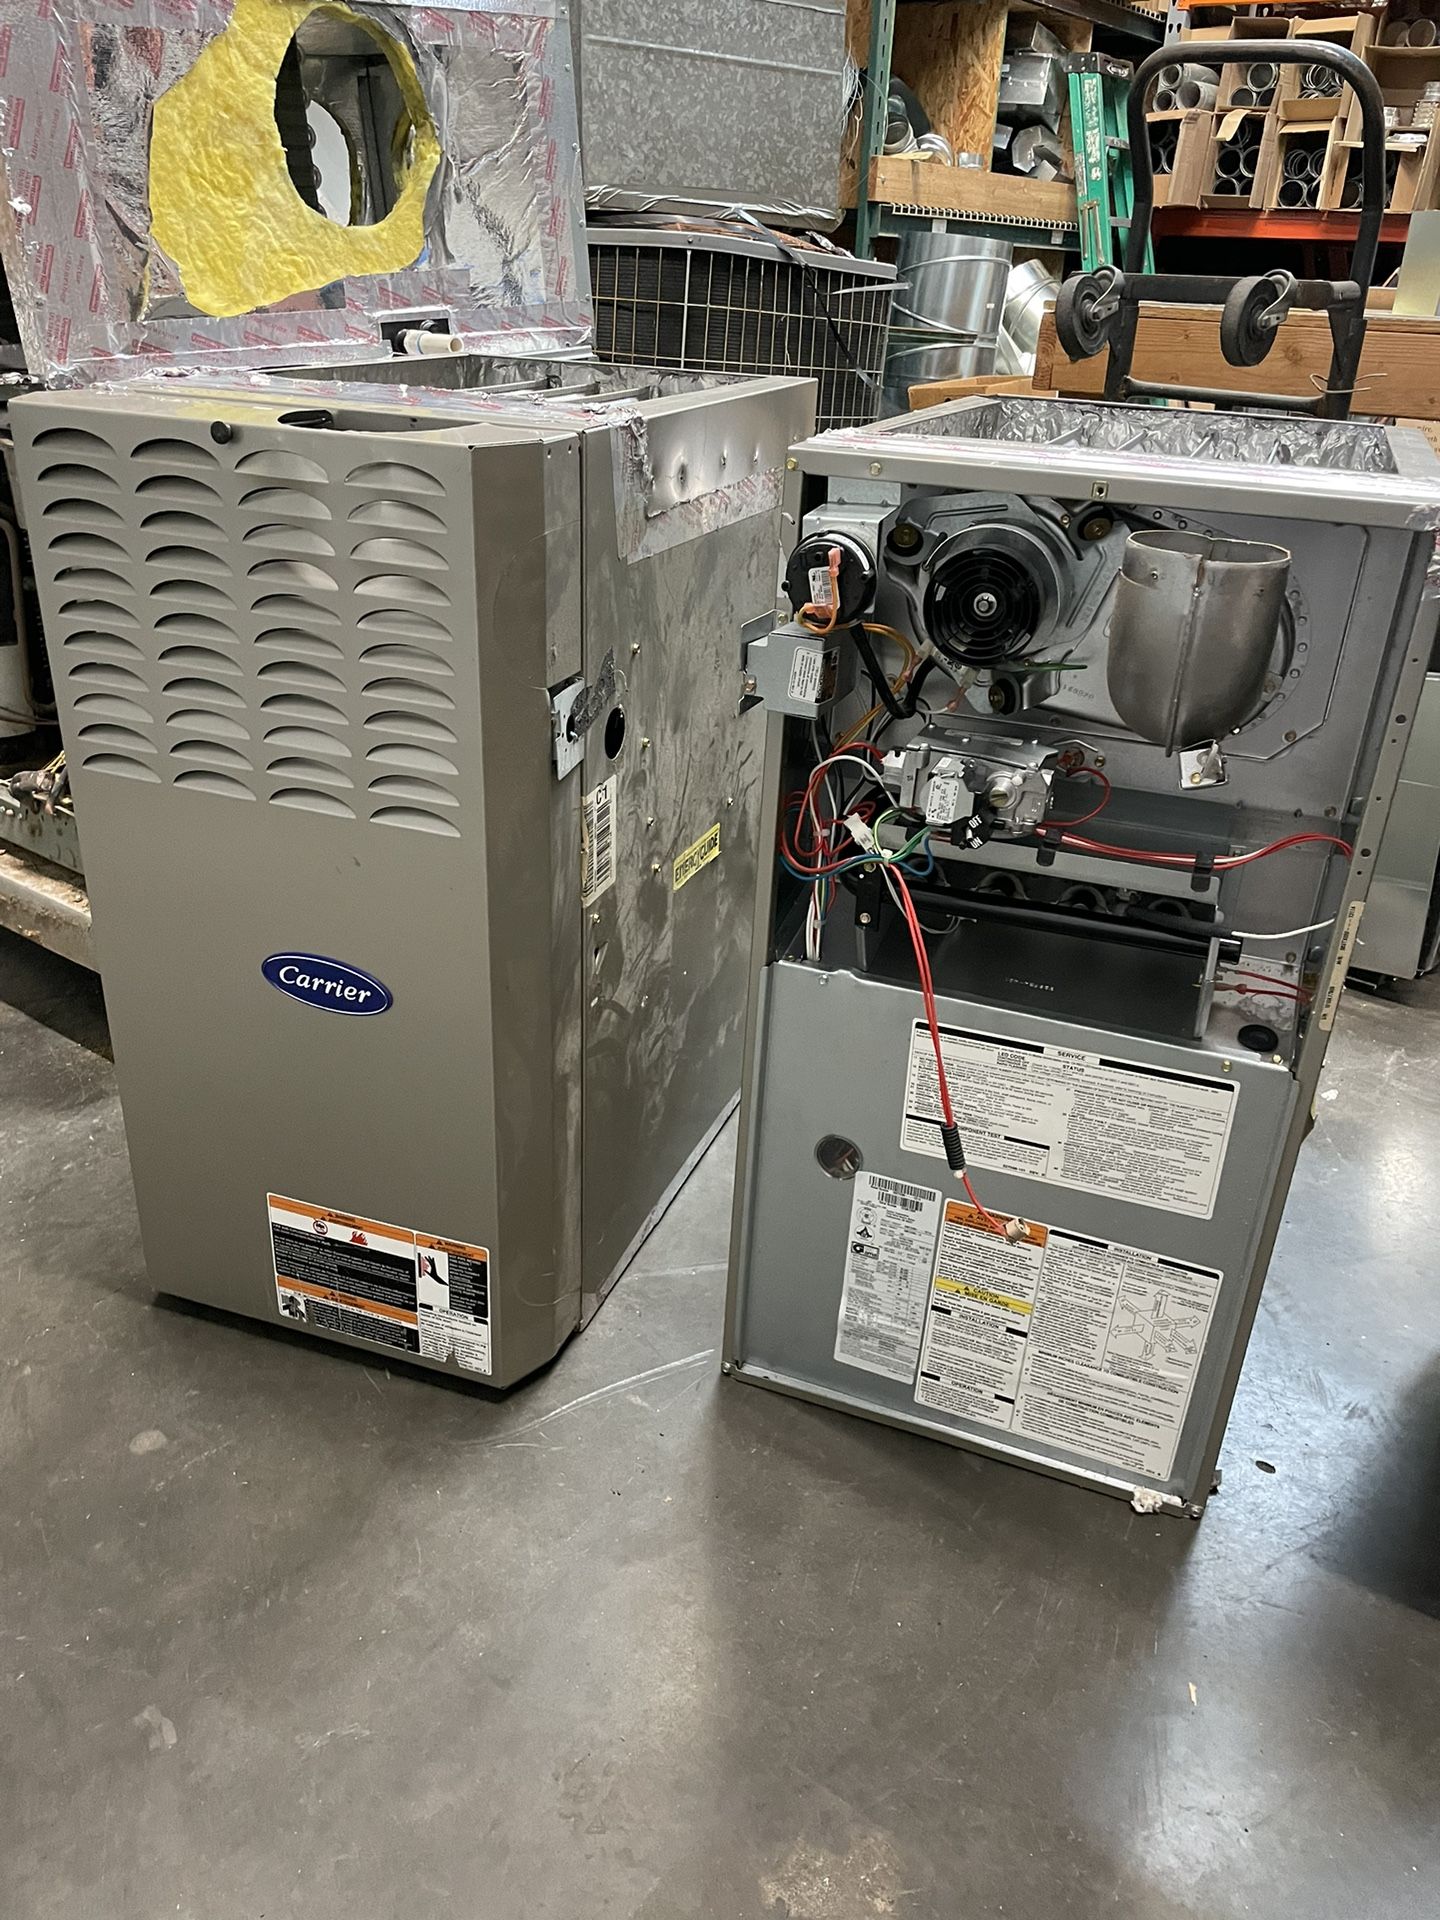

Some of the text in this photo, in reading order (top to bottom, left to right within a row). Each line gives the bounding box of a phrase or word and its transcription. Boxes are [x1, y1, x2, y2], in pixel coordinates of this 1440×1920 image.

[596, 785, 608, 805] C1
[969, 814, 982, 828] OFF
[279, 966, 371, 1003] Carrier
[1010, 1053, 1025, 1061] CODE
[1058, 1051, 1086, 1061] SERVICE
[1063, 1064, 1085, 1073] STATUS
[987, 1131, 1001, 1139] TEST
[1114, 1247, 1152, 1260] INSTALLATION
[973, 1288, 999, 1299] CAUTION
[439, 1308, 469, 1320] OPERATION
[959, 1314, 1000, 1329] INSTALLATION
[951, 1381, 983, 1394] OPERATION
